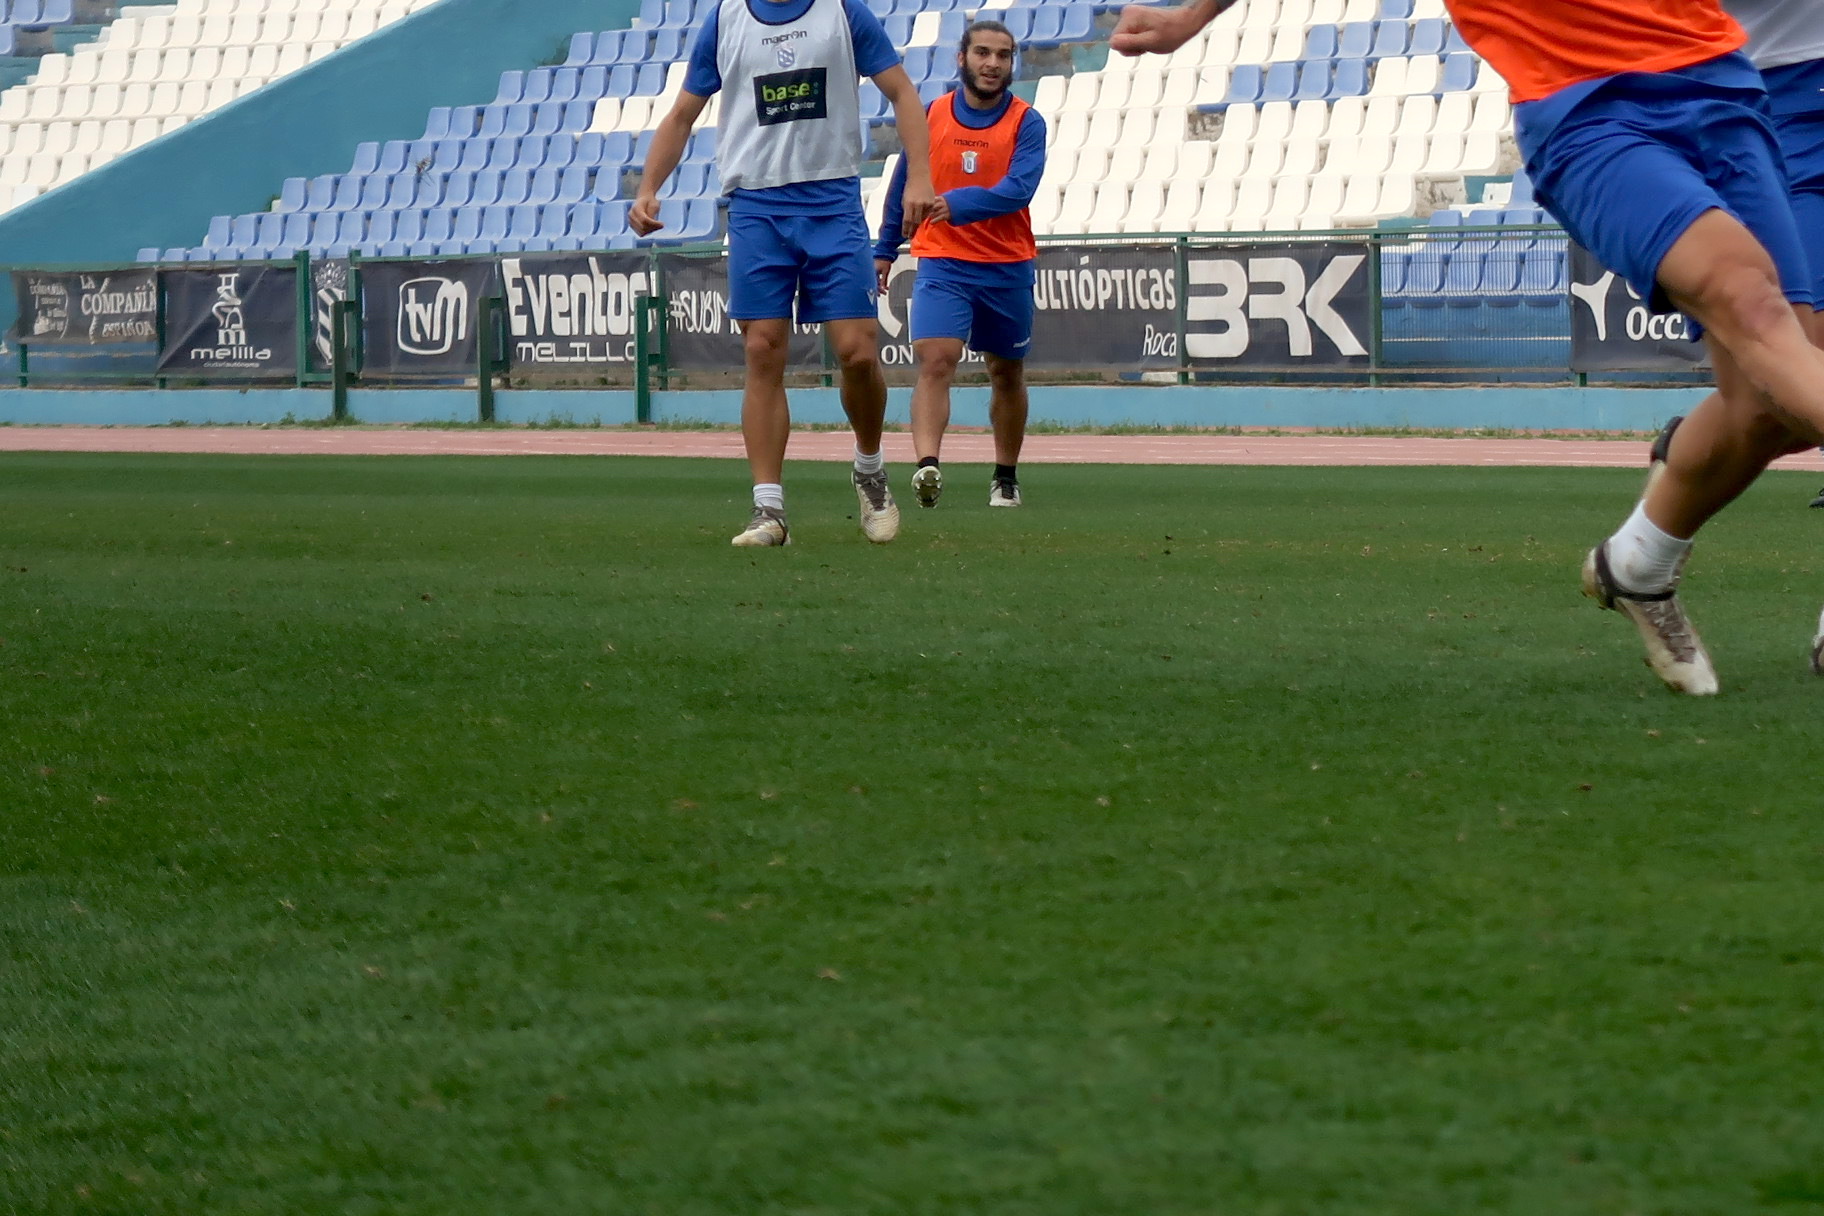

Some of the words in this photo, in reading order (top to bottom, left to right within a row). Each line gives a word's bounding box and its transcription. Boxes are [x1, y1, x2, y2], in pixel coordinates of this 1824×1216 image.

[761, 30, 808, 45] macron
[953, 138, 989, 148] macron
[80, 274, 96, 290] LA
[1185, 255, 1369, 358] BRK
[190, 347, 272, 361] melilla
